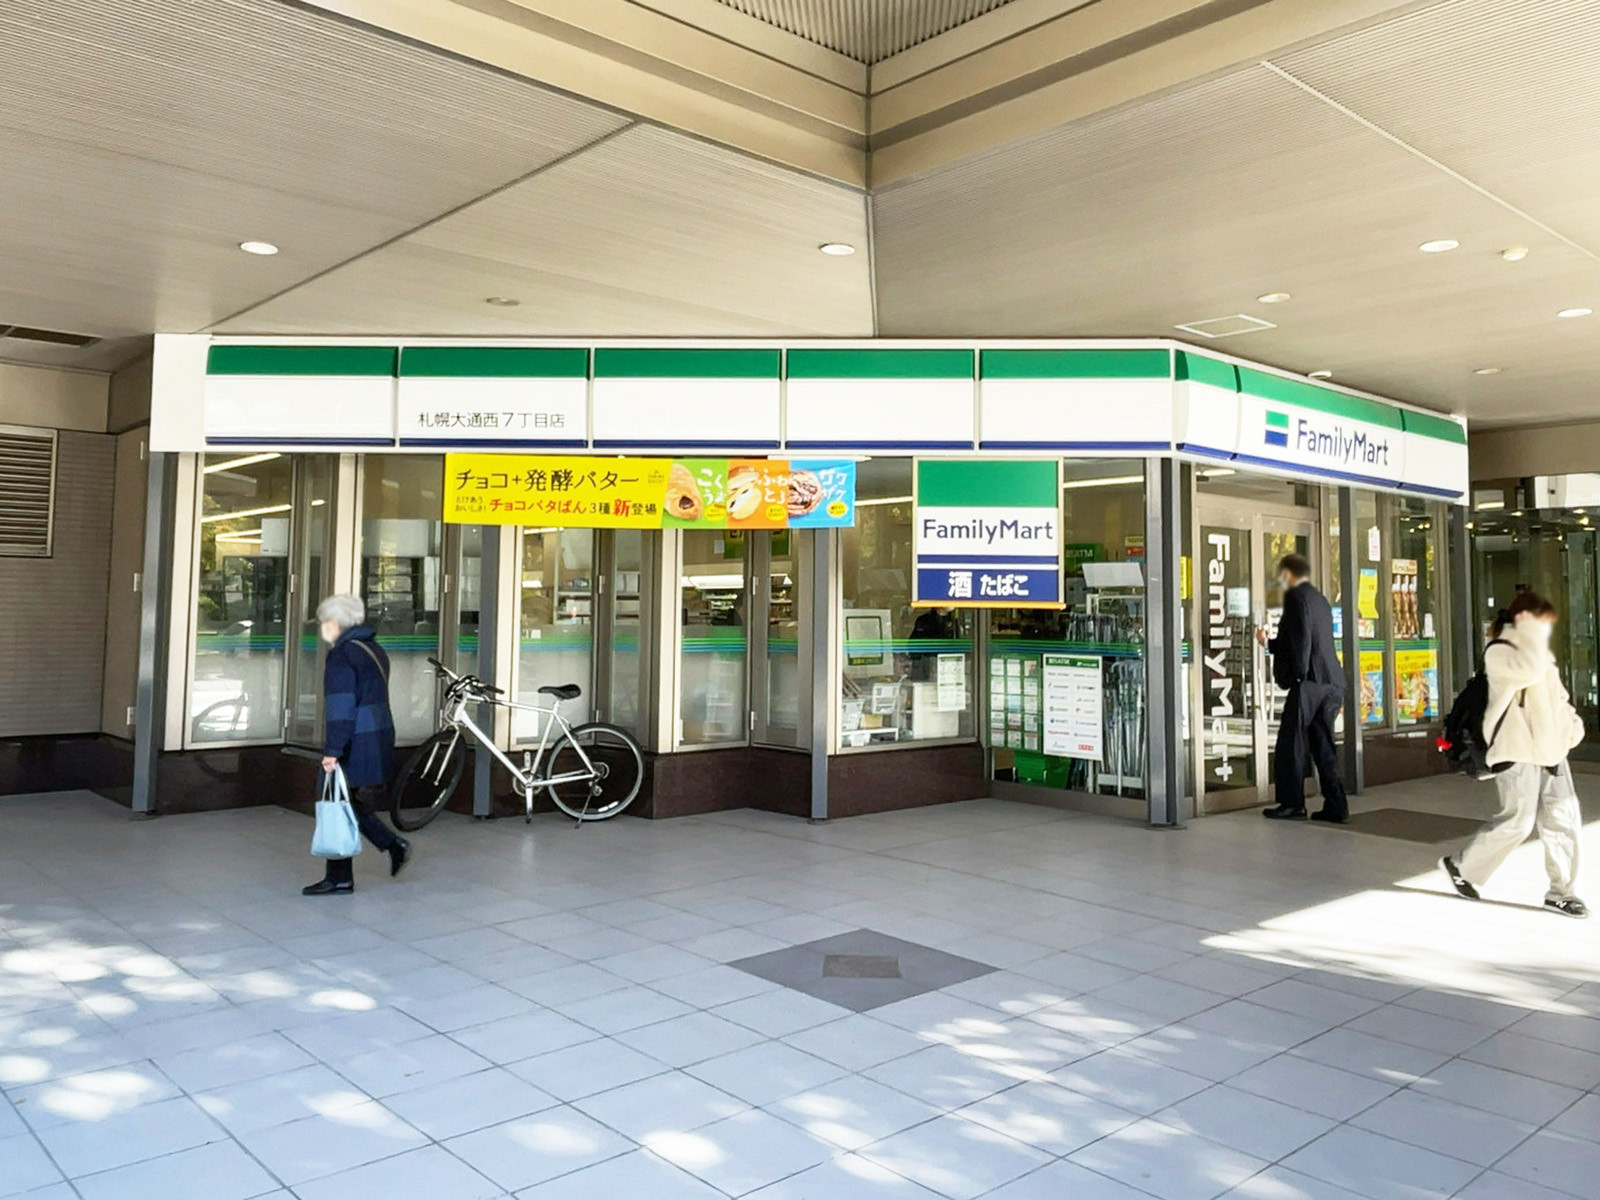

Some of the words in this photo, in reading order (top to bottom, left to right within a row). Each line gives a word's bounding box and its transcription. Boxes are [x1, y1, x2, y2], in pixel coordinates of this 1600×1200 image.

[418, 412, 565, 428] 札幌大通西7丁目店
[1297, 418, 1388, 466] FamilyMart
[455, 468, 639, 492] チョコ+発酵バター
[923, 519, 1053, 544] FamilyMart
[948, 571, 973, 598] 酒
[980, 574, 1029, 597] たばこ
[1204, 533, 1234, 782] FamilyMart
